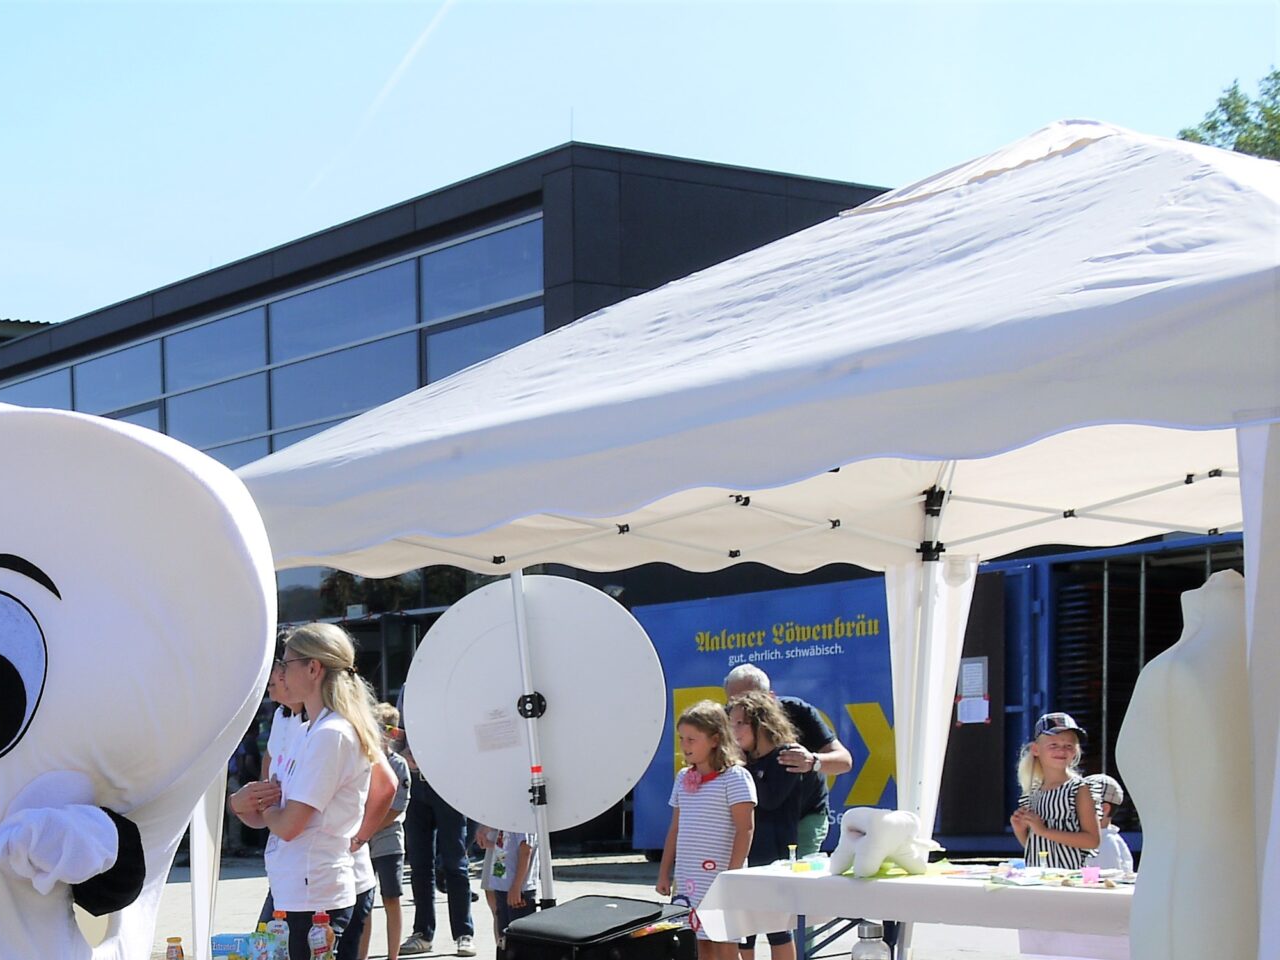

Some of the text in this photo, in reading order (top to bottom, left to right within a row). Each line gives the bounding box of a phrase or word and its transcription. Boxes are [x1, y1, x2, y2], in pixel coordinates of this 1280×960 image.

[695, 614, 880, 652] Aalener Löwenbräu
[728, 643, 844, 666] gut. ehrlich. schwäbisch.
